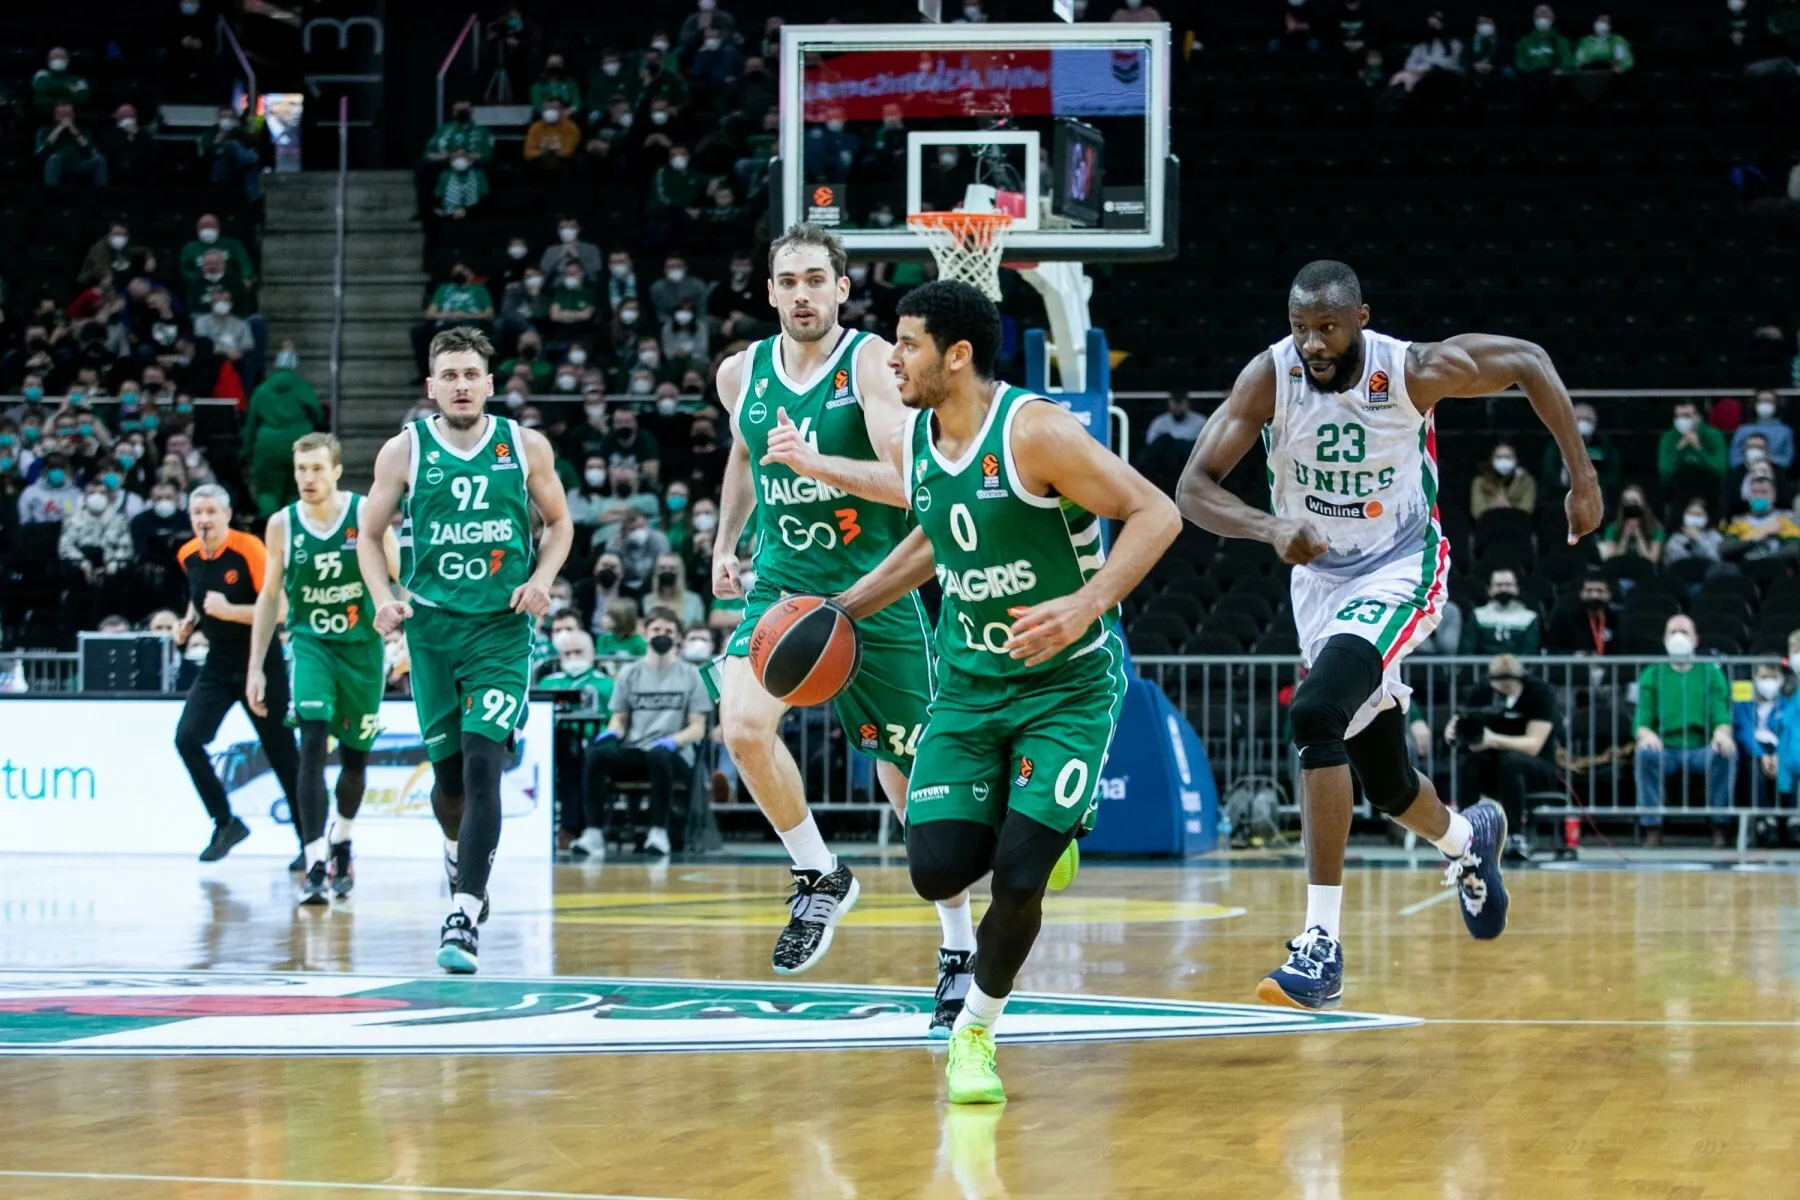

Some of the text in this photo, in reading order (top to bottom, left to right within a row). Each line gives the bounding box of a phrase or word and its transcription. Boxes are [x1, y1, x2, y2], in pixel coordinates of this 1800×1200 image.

[1316, 423, 1366, 463] 23
[451, 475, 490, 511] 92
[1294, 459, 1396, 497] UNICS
[1308, 497, 1360, 517] Winline
[430, 519, 513, 545] ŽALGIRIS
[950, 503, 978, 551] 0
[314, 551, 343, 581] 55
[1336, 599, 1387, 625] 23
[482, 689, 517, 729] 92
[2, 758, 95, 799] tum
[1055, 758, 1088, 808] 0
